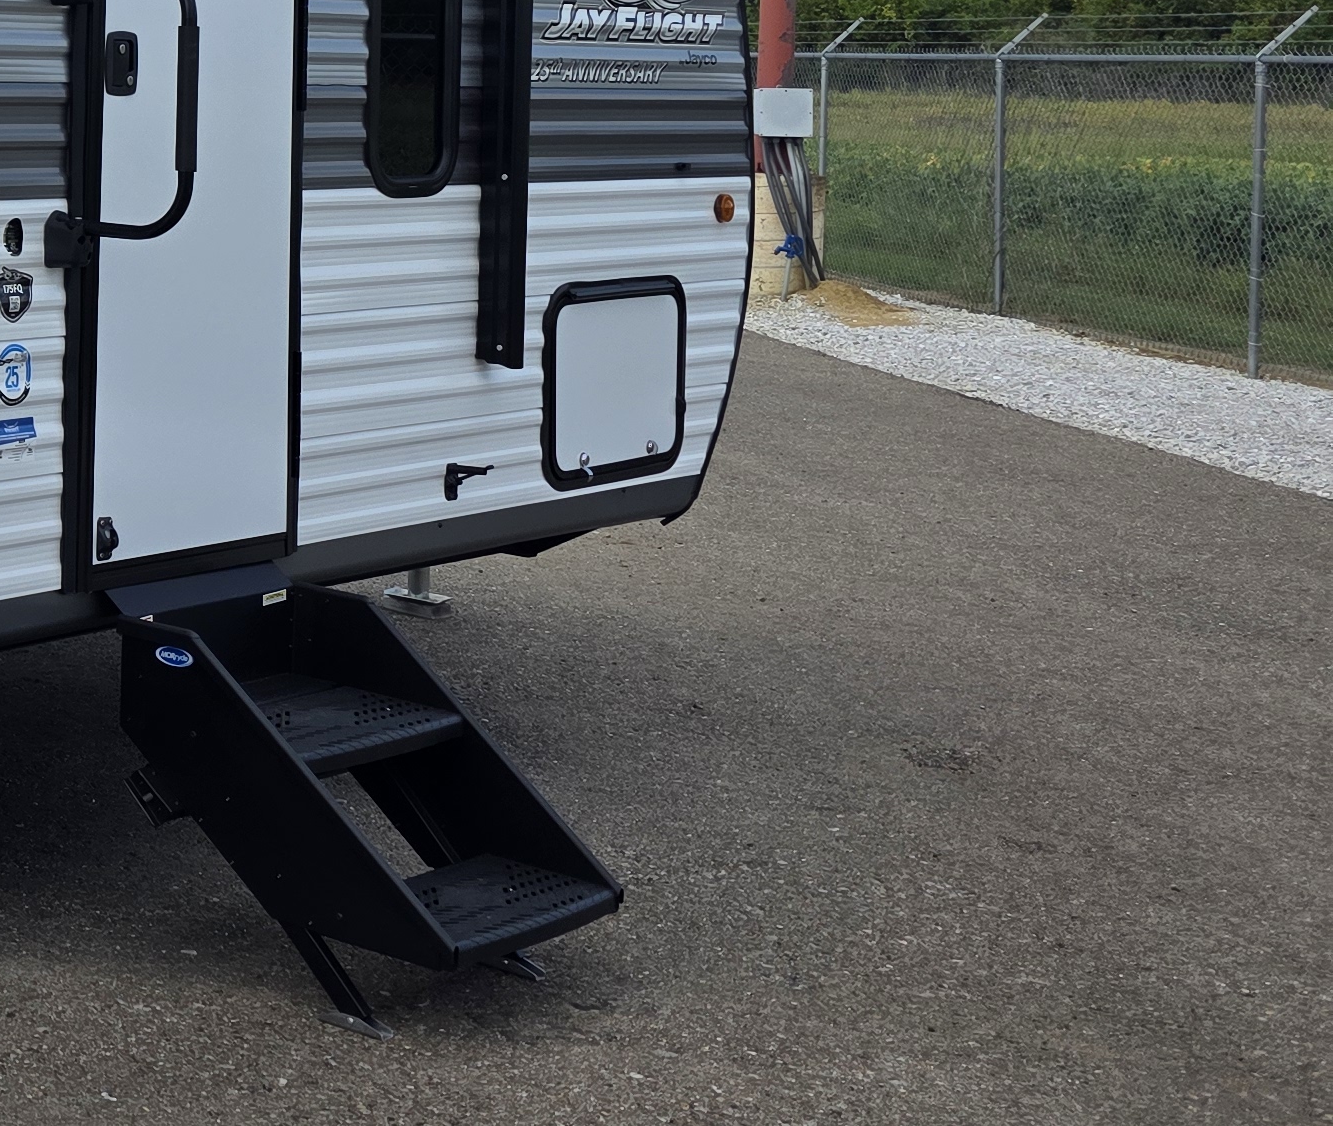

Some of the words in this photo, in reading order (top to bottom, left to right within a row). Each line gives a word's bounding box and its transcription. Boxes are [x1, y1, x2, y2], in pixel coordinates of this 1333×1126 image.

[542, 0, 613, 42] JAY
[608, 6, 726, 45] FLIGHT
[685, 50, 718, 69] Jayco
[562, 60, 668, 84] ANNIVERSARY
[5, 365, 20, 388] 25
